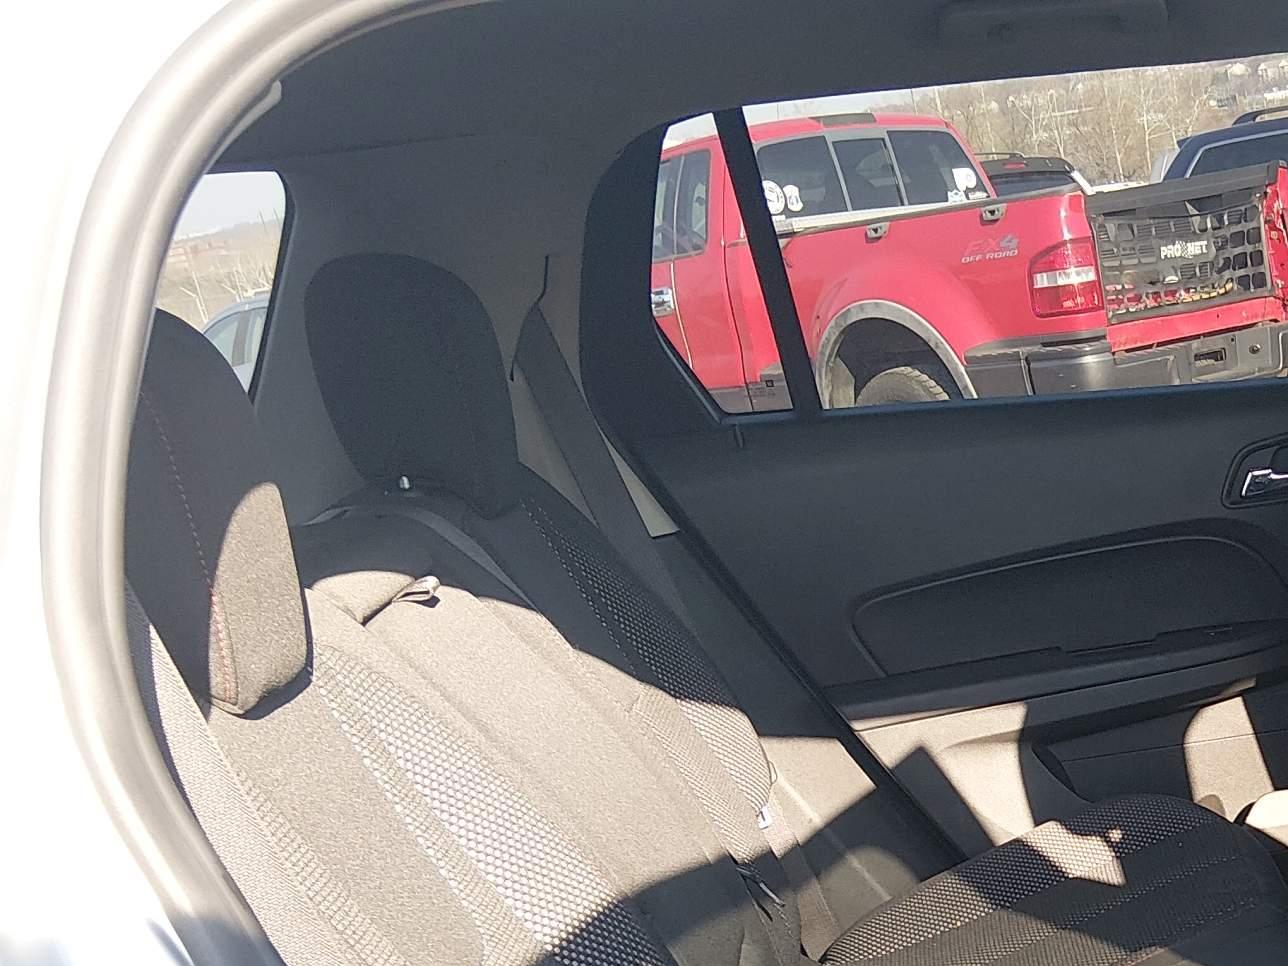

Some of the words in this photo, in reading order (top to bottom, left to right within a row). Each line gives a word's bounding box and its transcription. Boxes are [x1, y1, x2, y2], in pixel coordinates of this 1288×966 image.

[964, 234, 1019, 255] FX4
[961, 254, 983, 264] OFF
[985, 248, 1019, 261] ROAD
